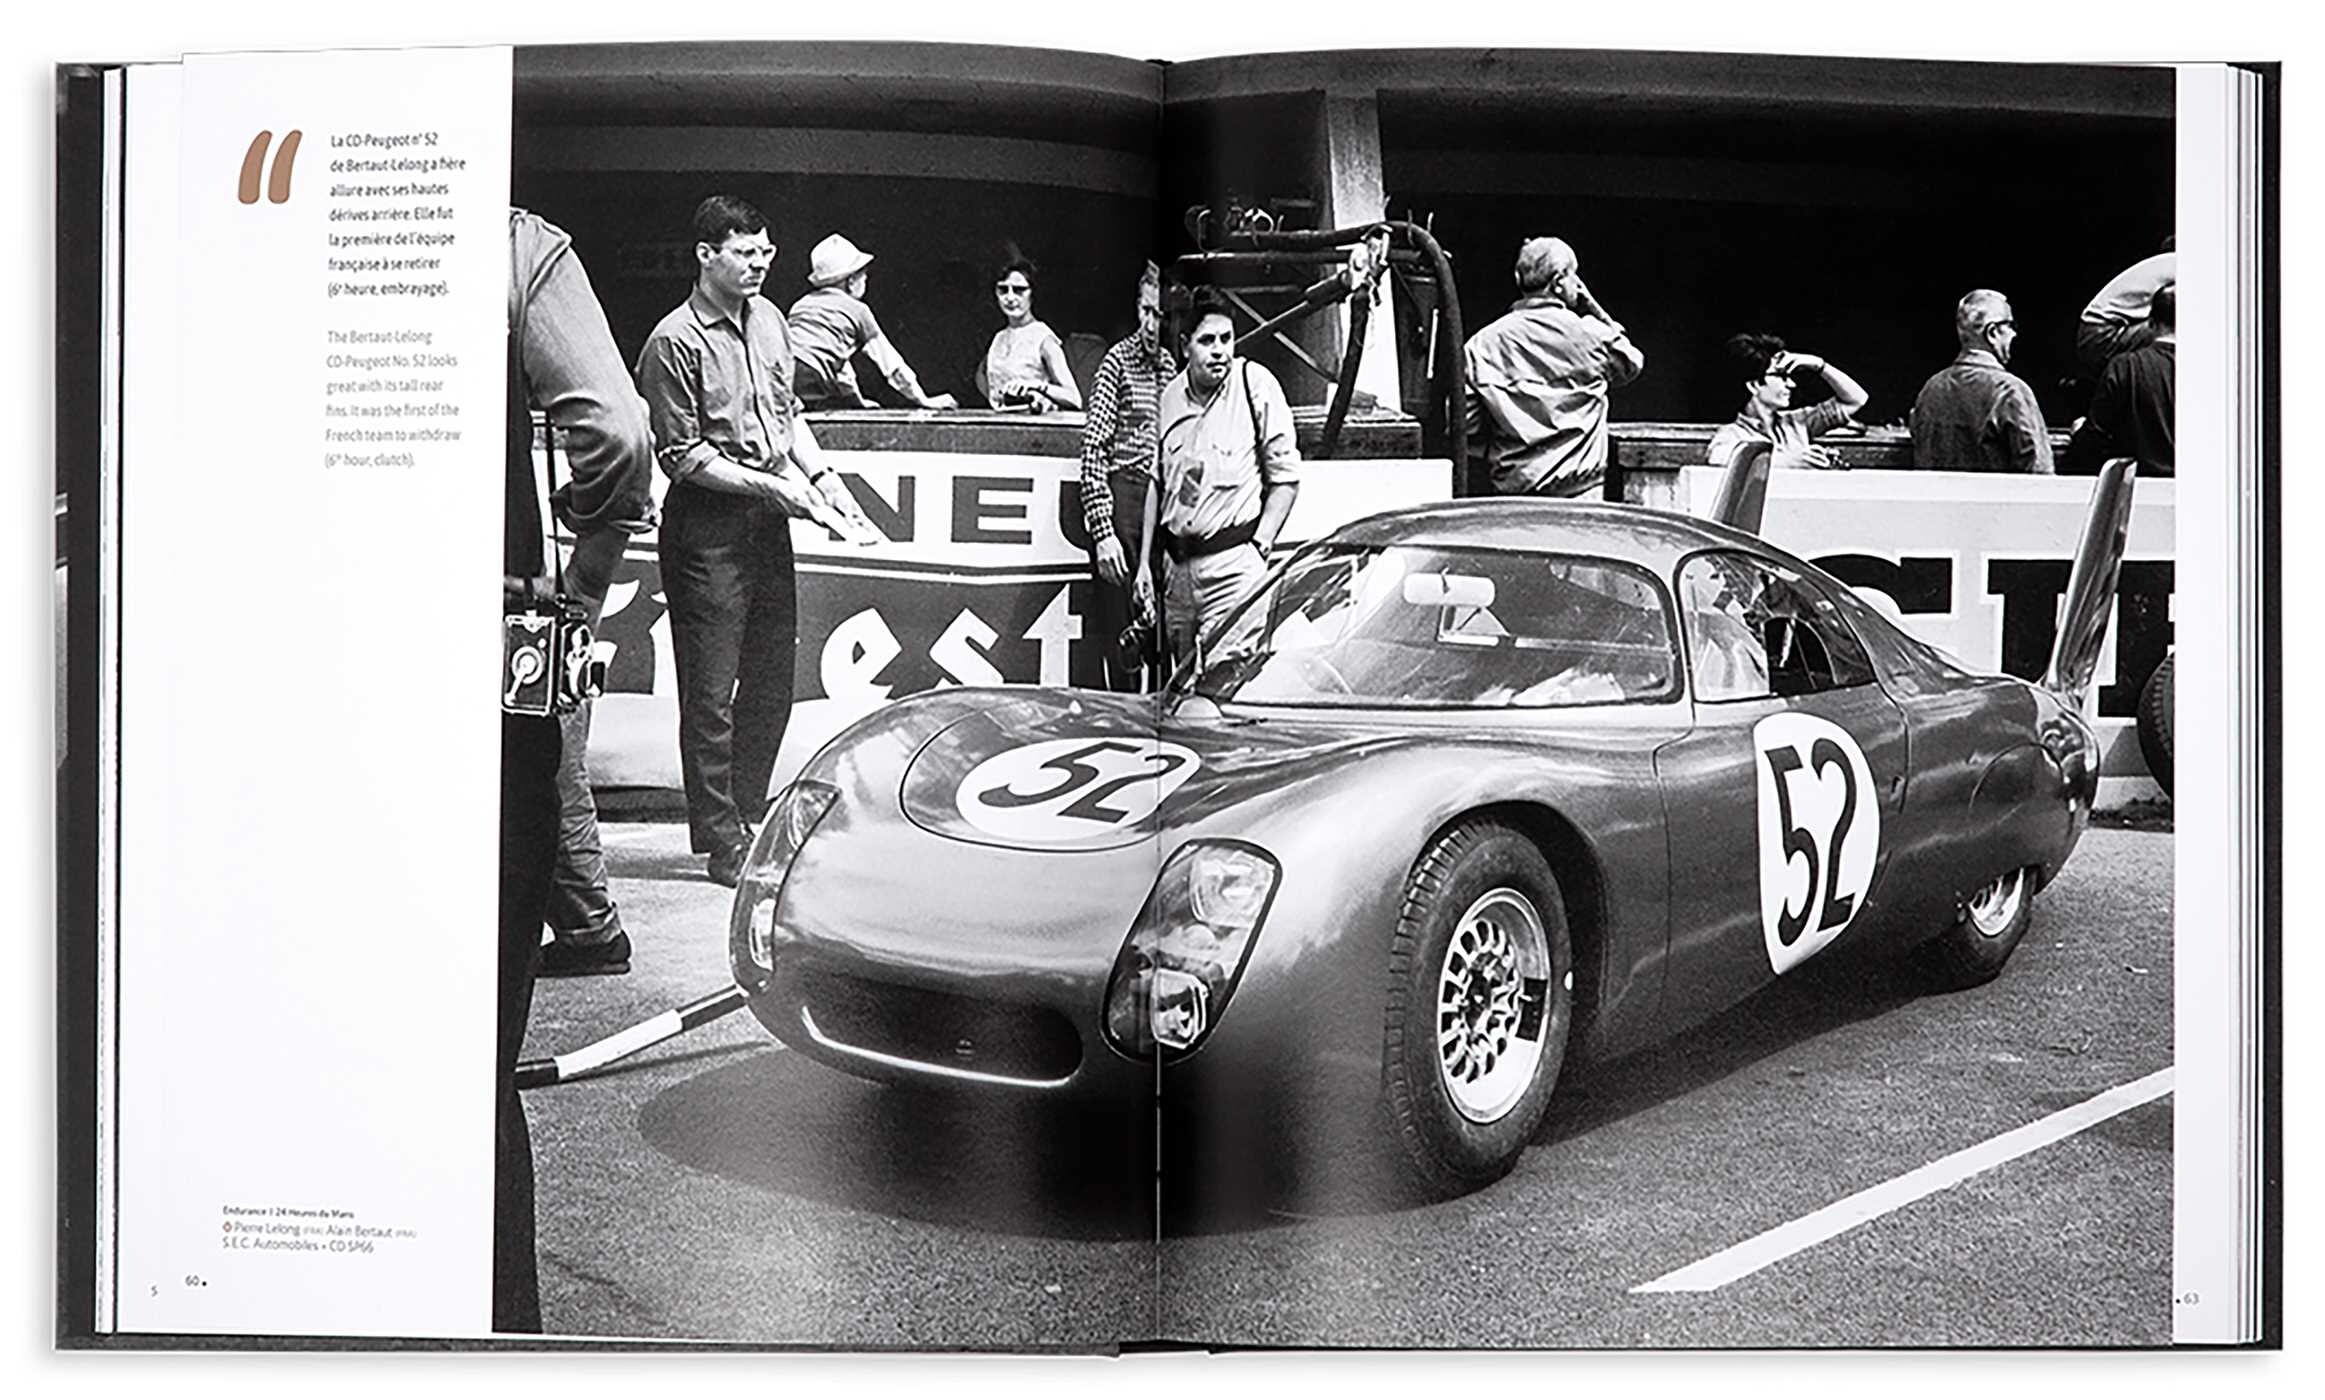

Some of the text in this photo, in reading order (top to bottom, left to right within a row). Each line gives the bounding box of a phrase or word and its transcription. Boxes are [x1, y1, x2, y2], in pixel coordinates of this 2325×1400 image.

[331, 135, 343, 147] La
[346, 133, 410, 150] CD-Peugeot
[424, 132, 438, 146] 52
[330, 156, 466, 173] de Bertaut-Lelong a fière
[330, 182, 449, 197] allure avec ses hautes
[329, 208, 369, 222] dérives
[414, 207, 435, 221] Elle
[437, 206, 454, 219] fut
[342, 232, 392, 248] première
[394, 232, 408, 246] de
[328, 257, 380, 273] française
[391, 260, 403, 271] se
[404, 257, 441, 270] retirer
[328, 330, 432, 346] The Bertaut-Lelong
[326, 354, 391, 371] CD-Peugeot
[412, 354, 426, 367] 52
[428, 353, 458, 367] looks
[326, 379, 444, 396] great with its tall rear
[361, 406, 382, 417] was
[384, 404, 402, 417] the
[404, 403, 426, 417] first
[428, 402, 439, 416] of
[441, 404, 459, 416] the
[325, 428, 461, 442] French team to withdraw
[978, 740, 1186, 822] 52
[1765, 738, 1856, 947] 52
[223, 1205, 266, 1216] Endurance
[275, 1207, 287, 1217] 24
[234, 1221, 263, 1233] Pierre
[266, 1222, 300, 1237] Lelong
[326, 1224, 352, 1236] Alain
[355, 1225, 392, 1238] Bertaut
[253, 1237, 319, 1251] Automobiles
[329, 1241, 345, 1252] CD
